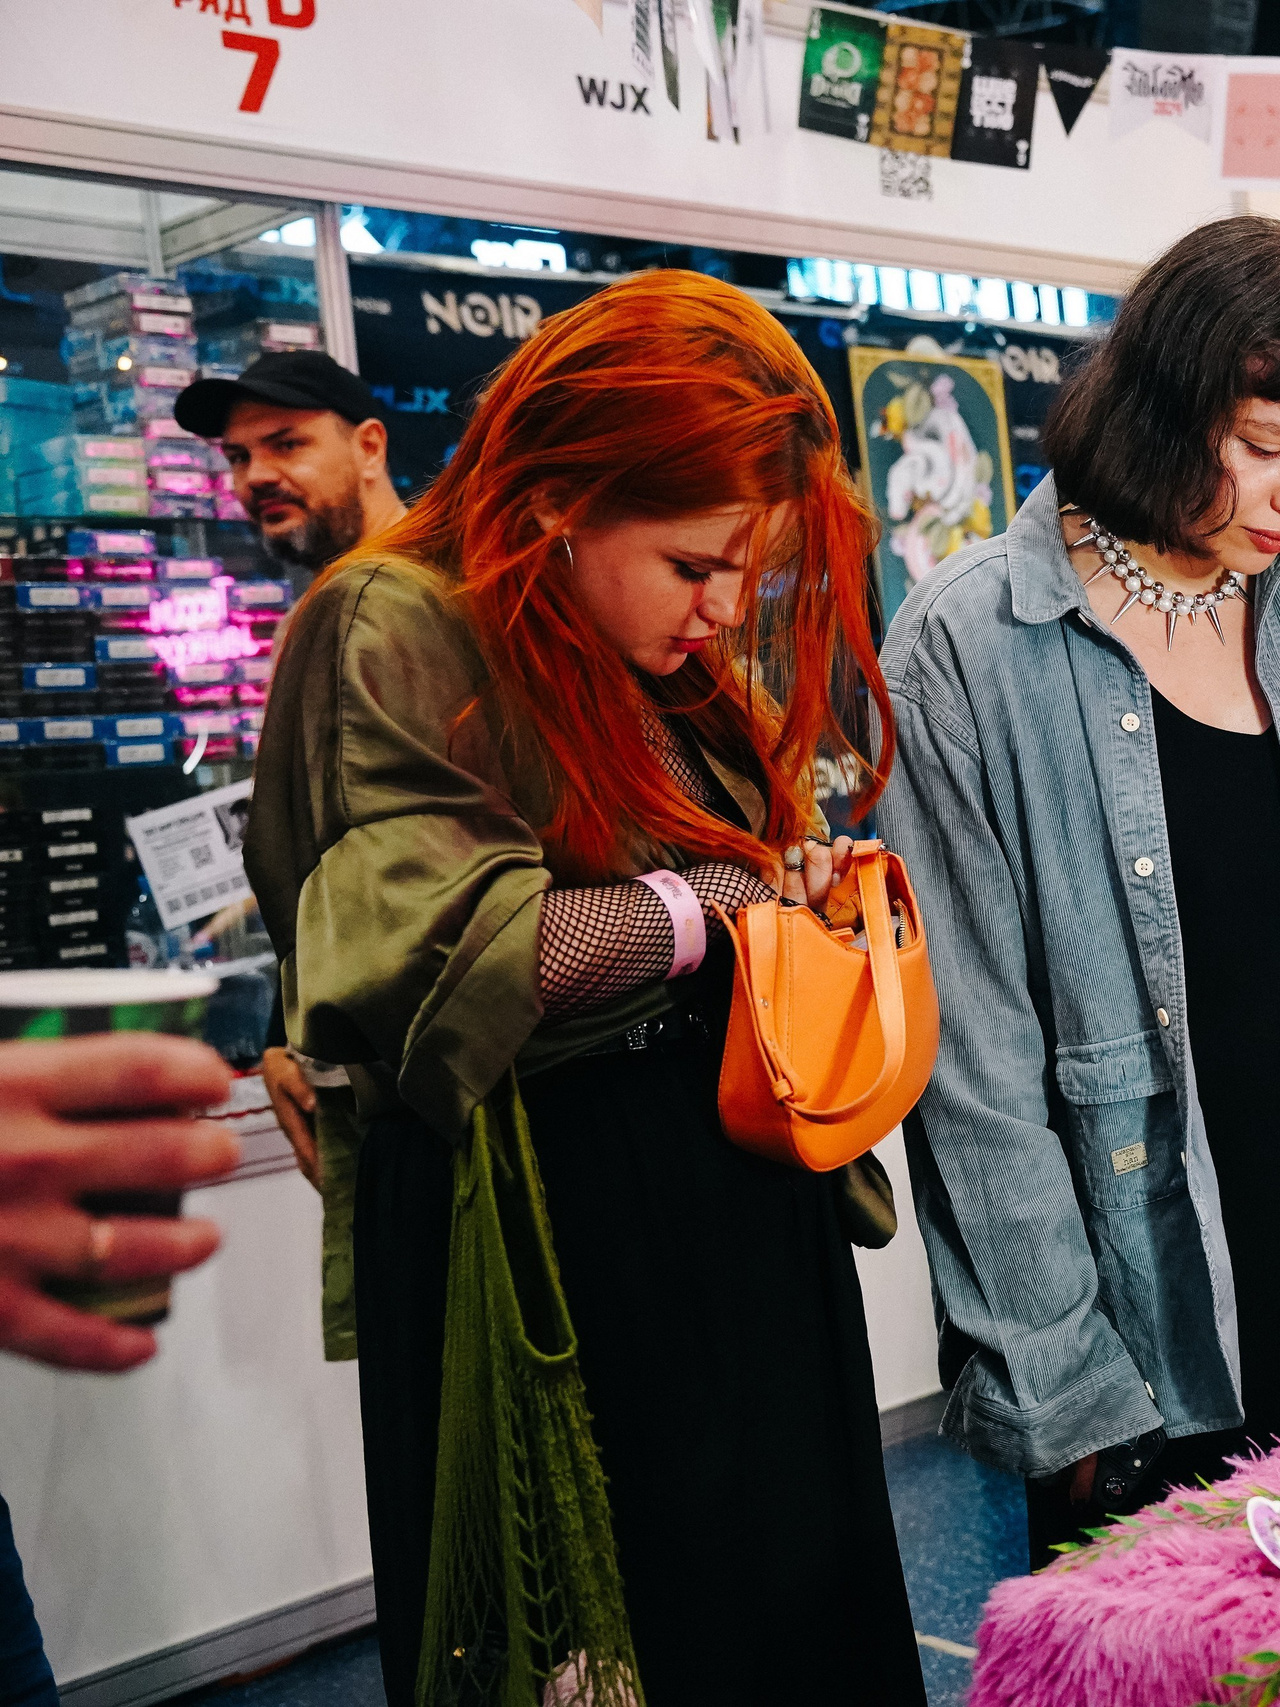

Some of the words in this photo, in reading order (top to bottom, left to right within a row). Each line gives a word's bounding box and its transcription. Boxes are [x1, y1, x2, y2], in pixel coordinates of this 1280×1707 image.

[220, 30, 280, 113] 7
[576, 74, 651, 116] WJX
[420, 290, 542, 339] NOIR
[1001, 345, 1062, 385] OIR
